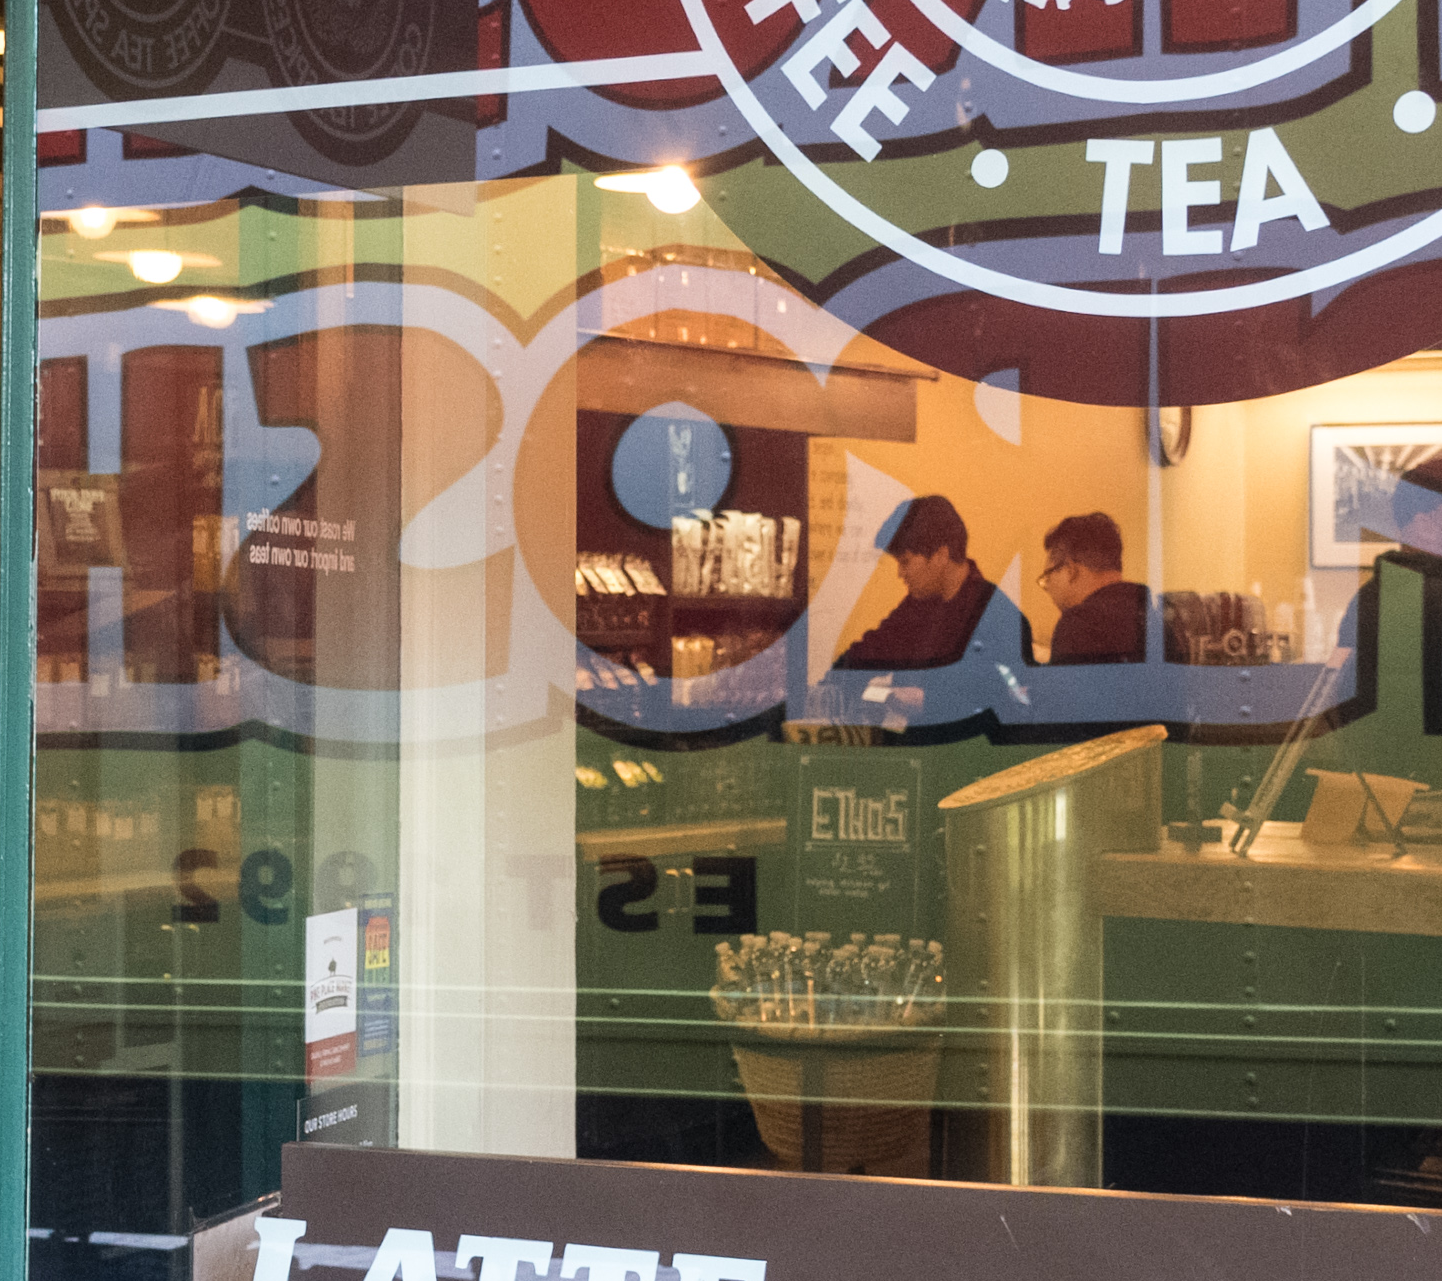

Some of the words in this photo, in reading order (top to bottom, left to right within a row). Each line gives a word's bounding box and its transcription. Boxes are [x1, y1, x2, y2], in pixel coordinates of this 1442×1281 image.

[1084, 127, 1330, 256] TEA
[304, 1117, 319, 1135] OUR
[318, 1110, 337, 1130] STORE
[337, 1104, 358, 1123] HOURS
